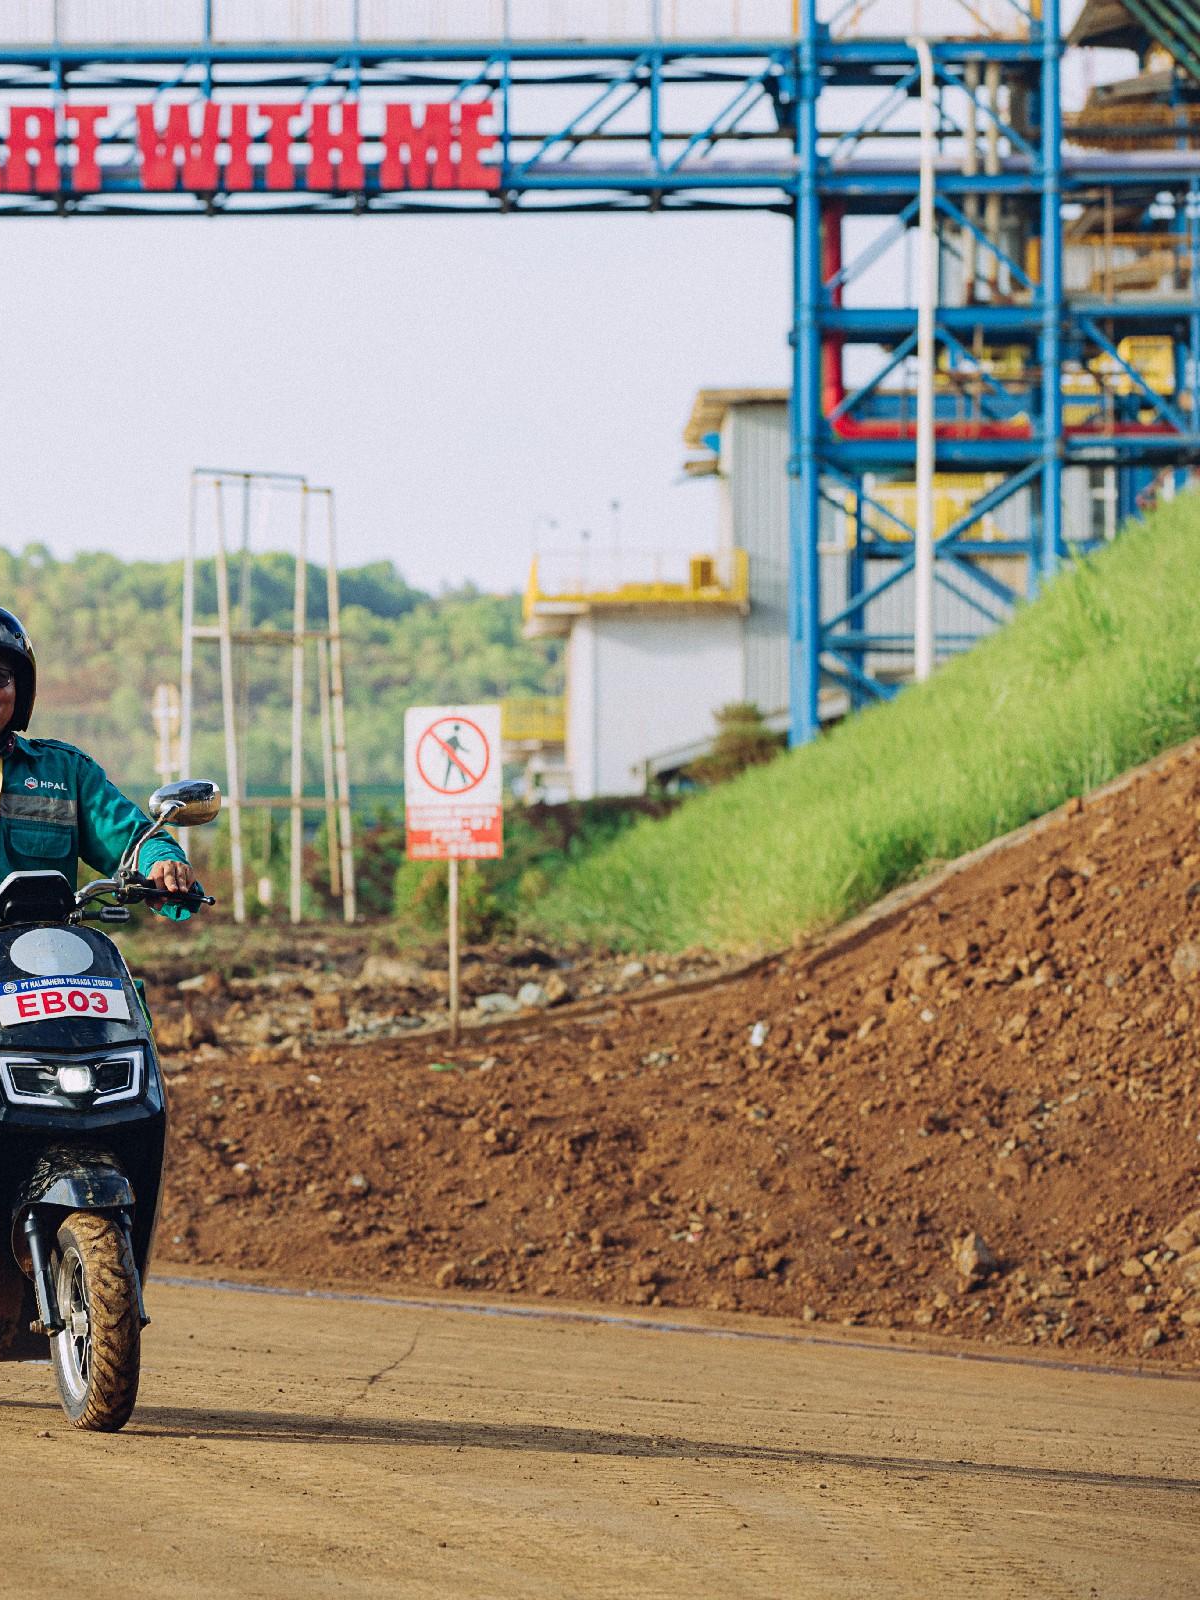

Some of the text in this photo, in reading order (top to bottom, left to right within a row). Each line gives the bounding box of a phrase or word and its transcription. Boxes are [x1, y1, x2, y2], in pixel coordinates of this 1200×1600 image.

[136, 103, 365, 190] WITH
[379, 102, 501, 189] ME
[40, 781, 68, 791] HPAL
[16, 991, 109, 1017] EB03
